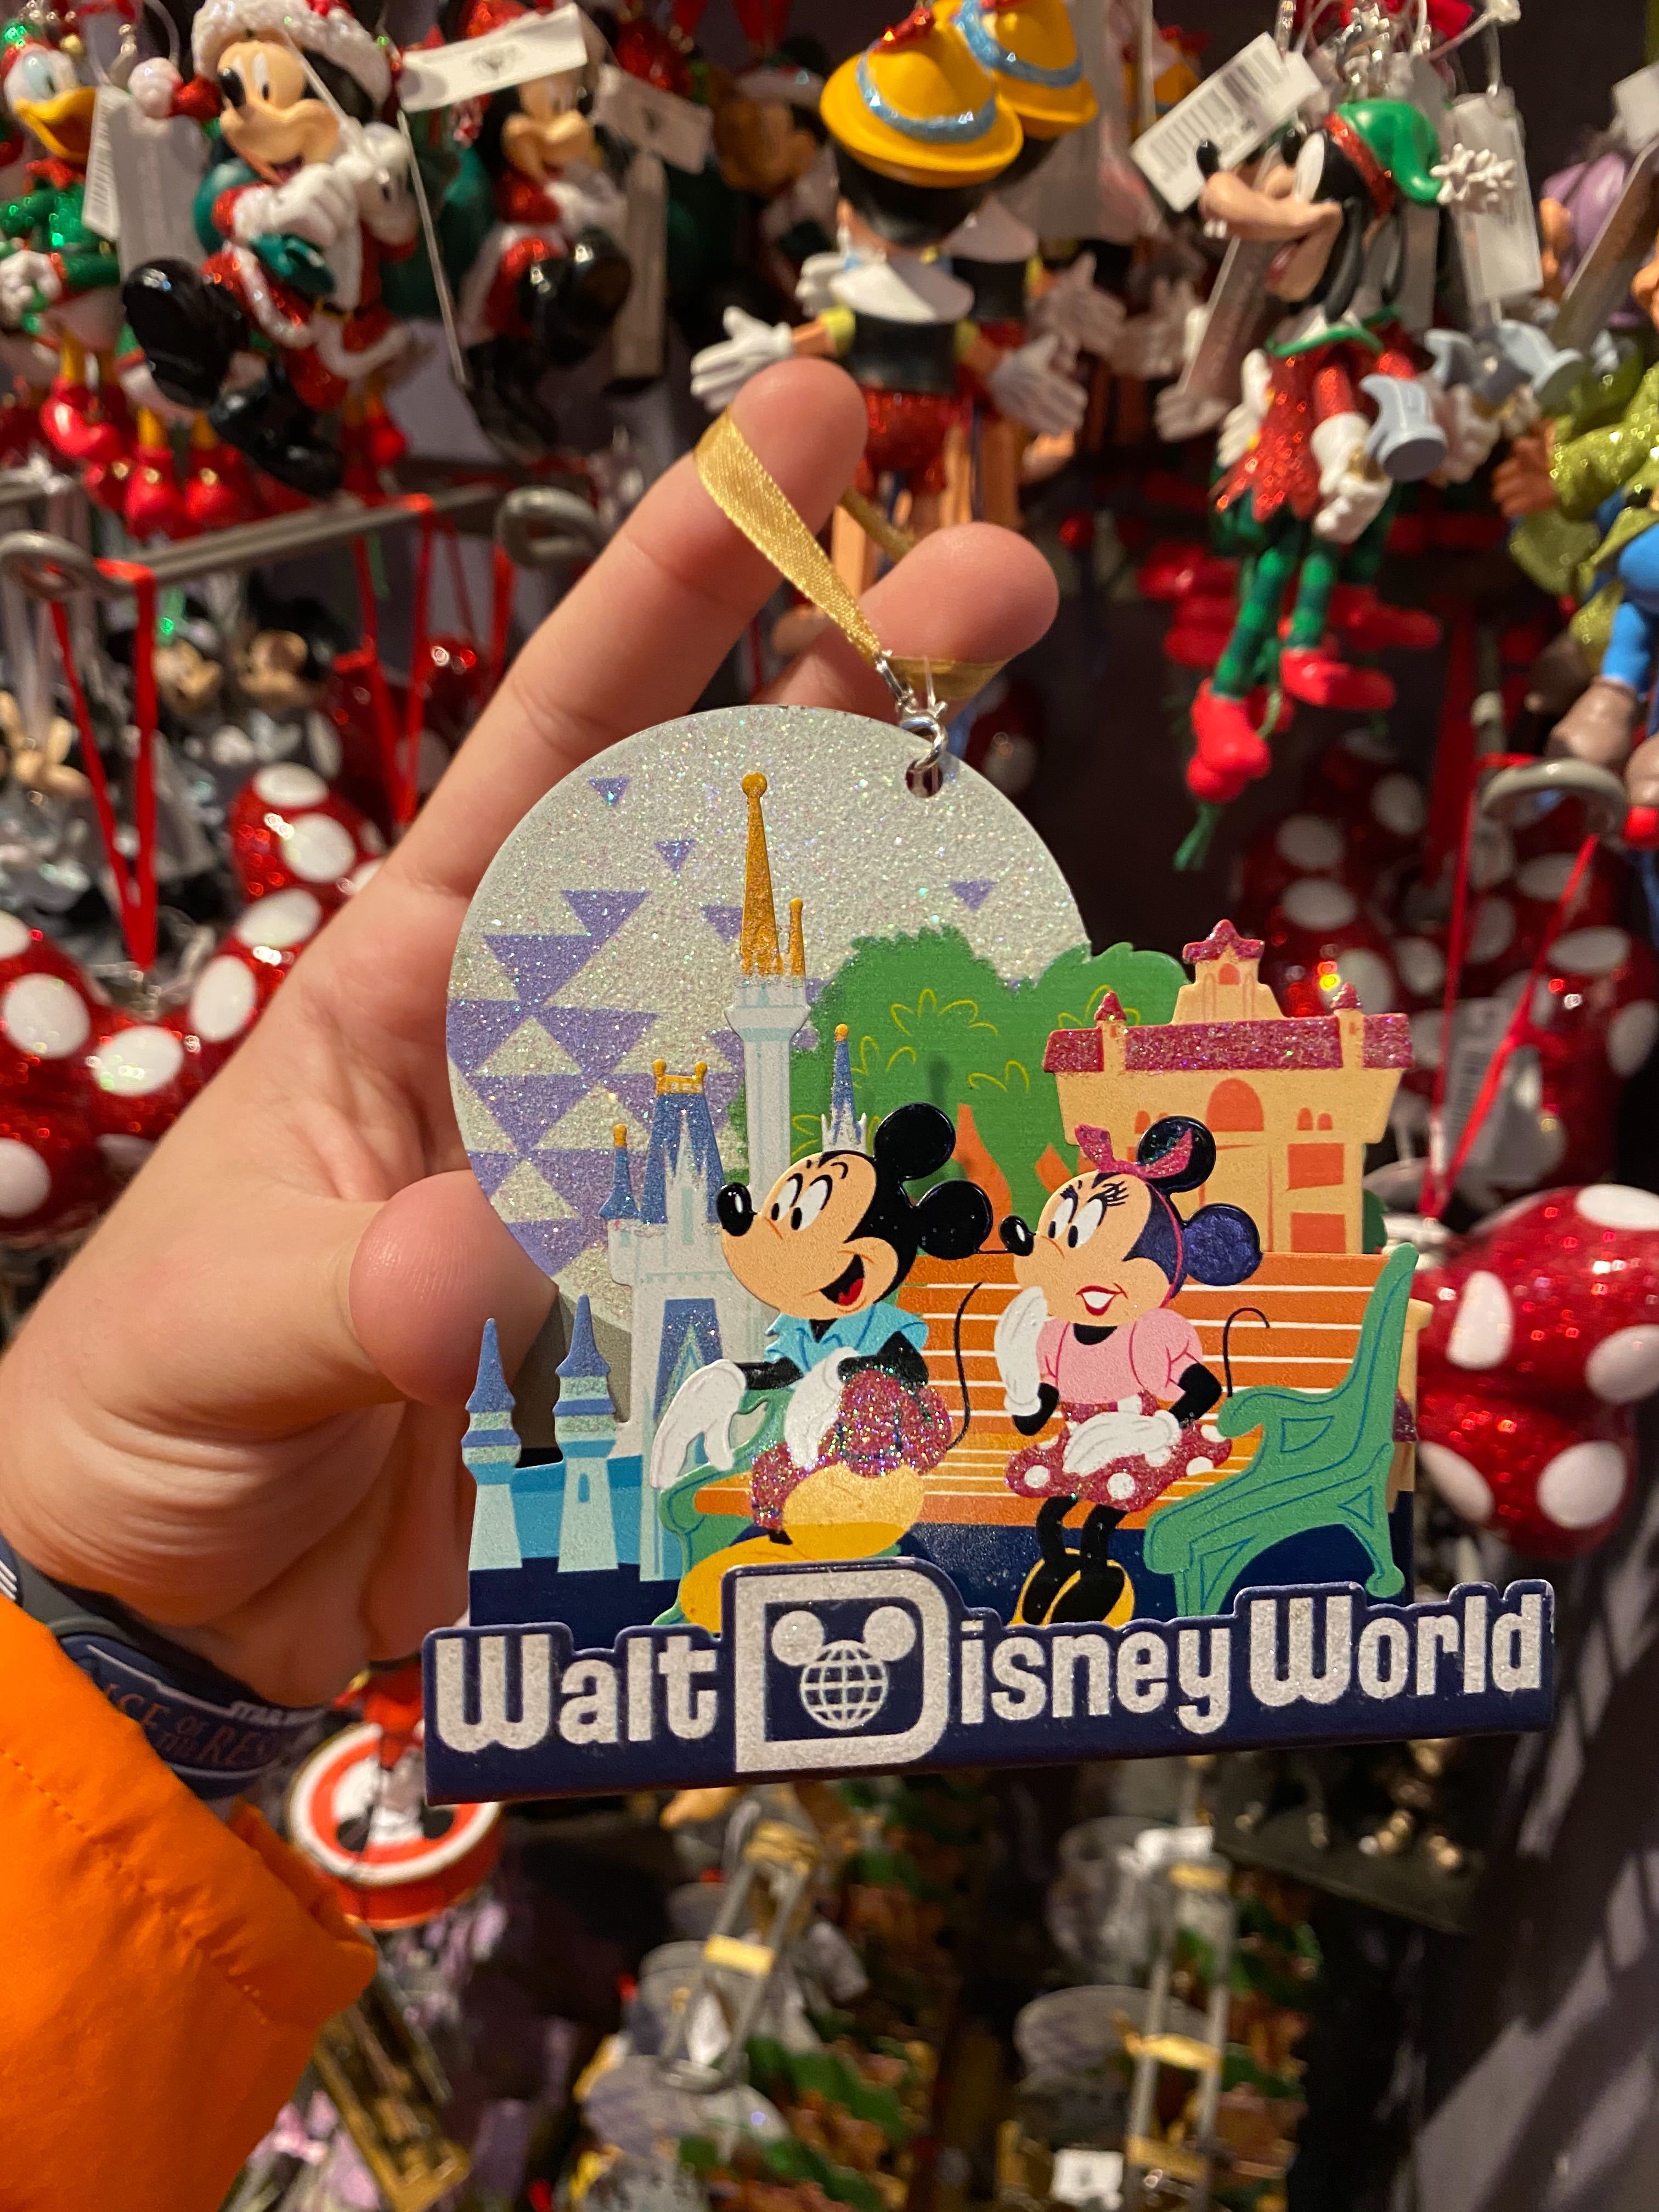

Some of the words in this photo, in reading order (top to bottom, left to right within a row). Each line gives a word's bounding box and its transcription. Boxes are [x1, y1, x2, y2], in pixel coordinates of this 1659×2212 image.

[436, 1633, 718, 1754] Walt
[735, 1568, 1232, 1773] Disney
[1249, 1593, 1542, 1707] World
